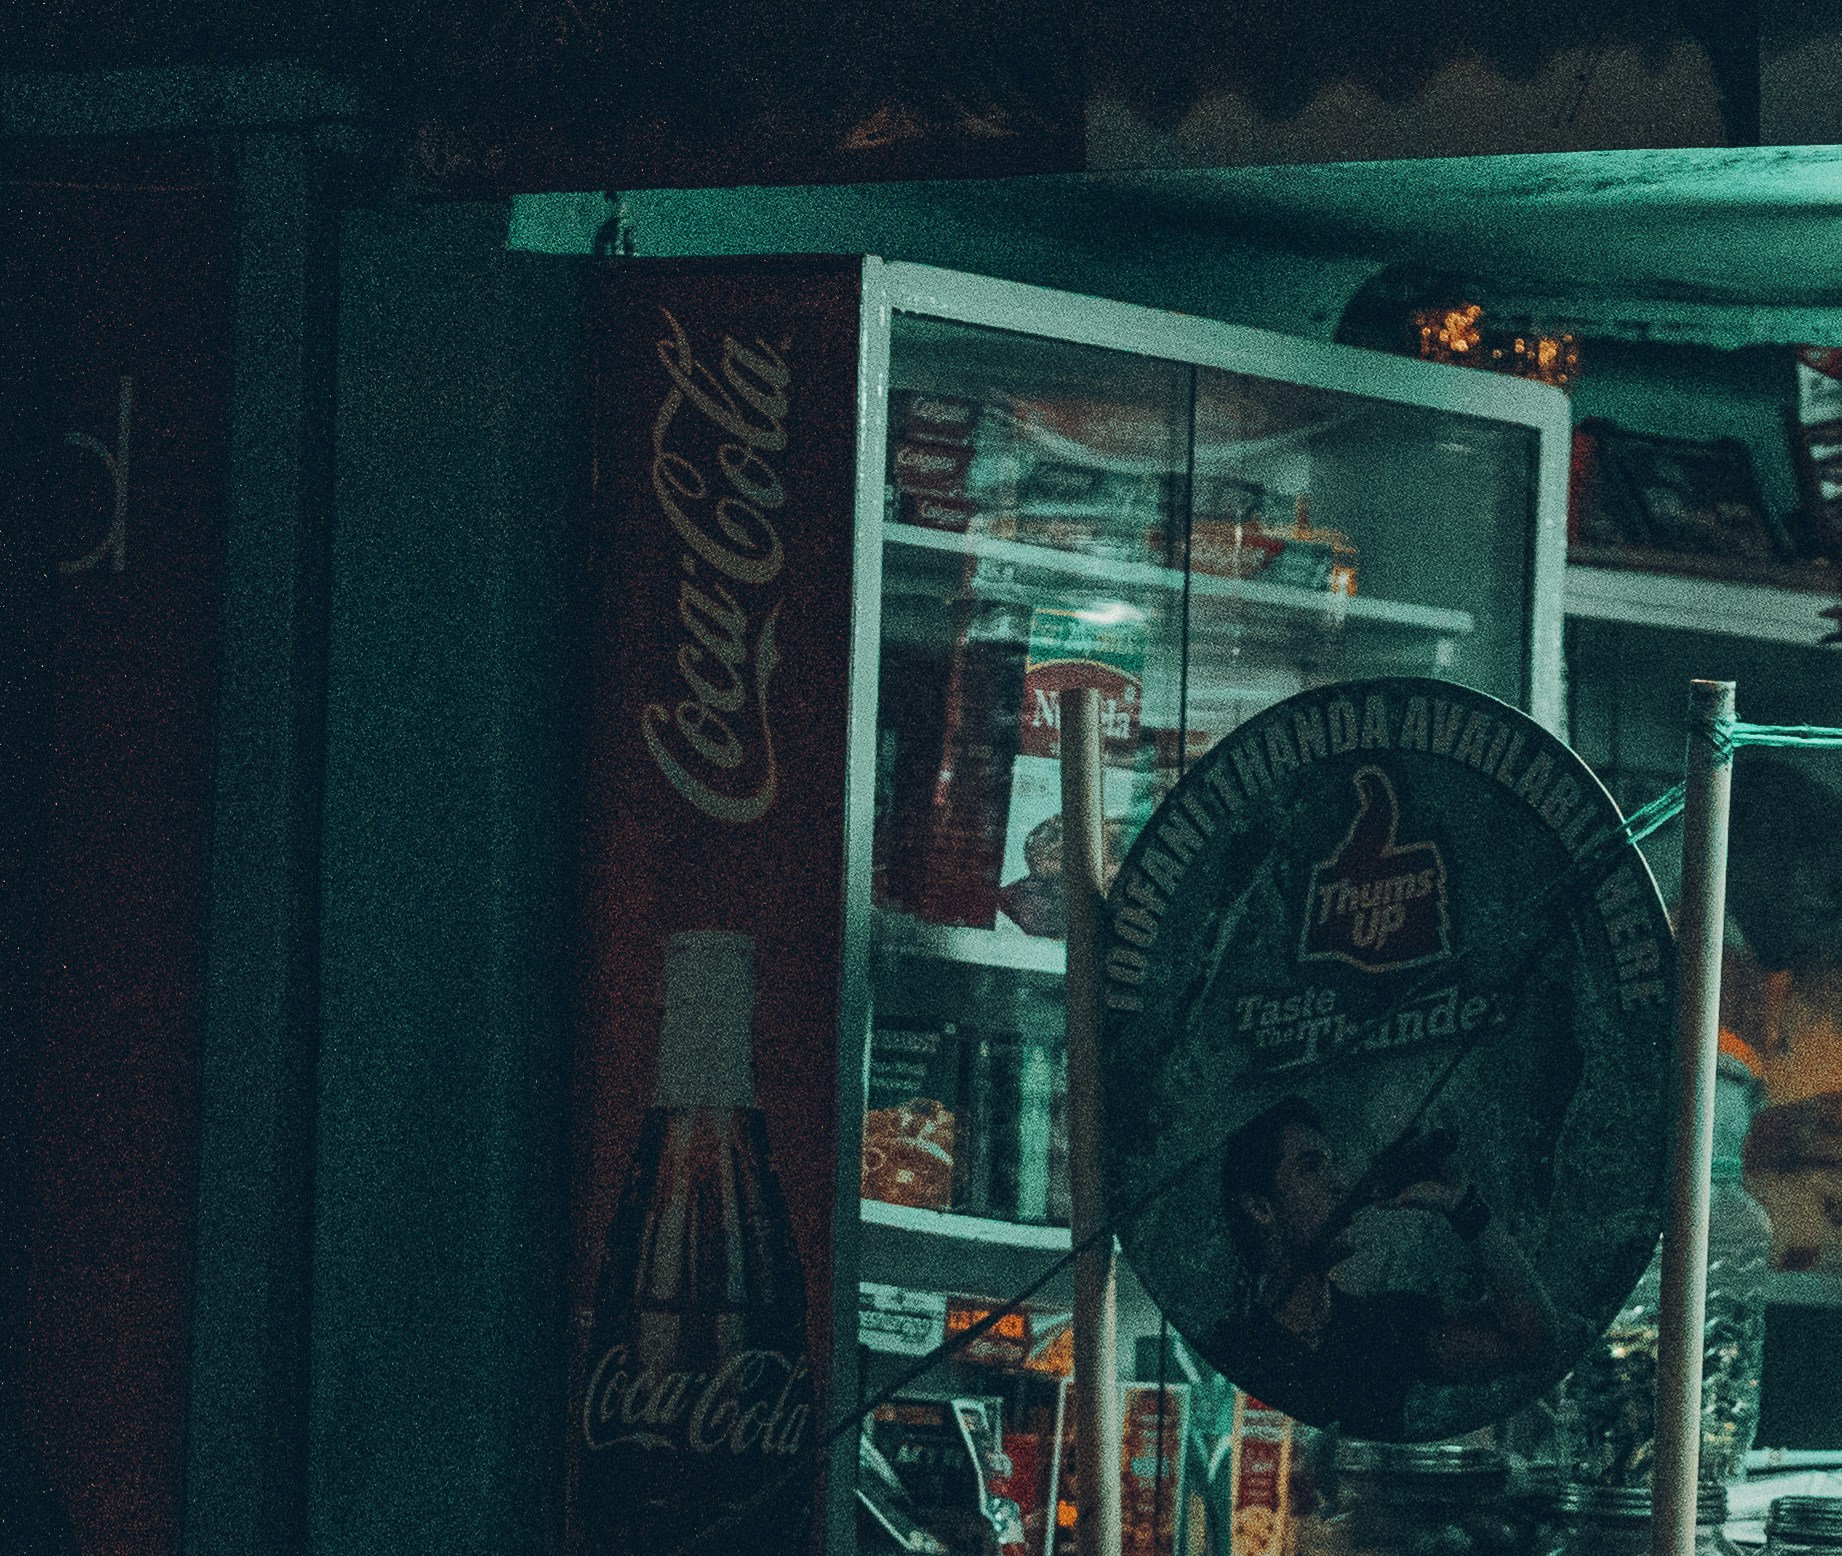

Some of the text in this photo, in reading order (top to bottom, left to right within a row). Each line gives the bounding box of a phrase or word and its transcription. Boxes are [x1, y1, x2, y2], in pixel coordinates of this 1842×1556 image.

[644, 304, 795, 824] Coca-Cola
[1203, 696, 1391, 812] THANDA
[1317, 867, 1436, 926] Thums
[1236, 986, 1338, 1032] Taste
